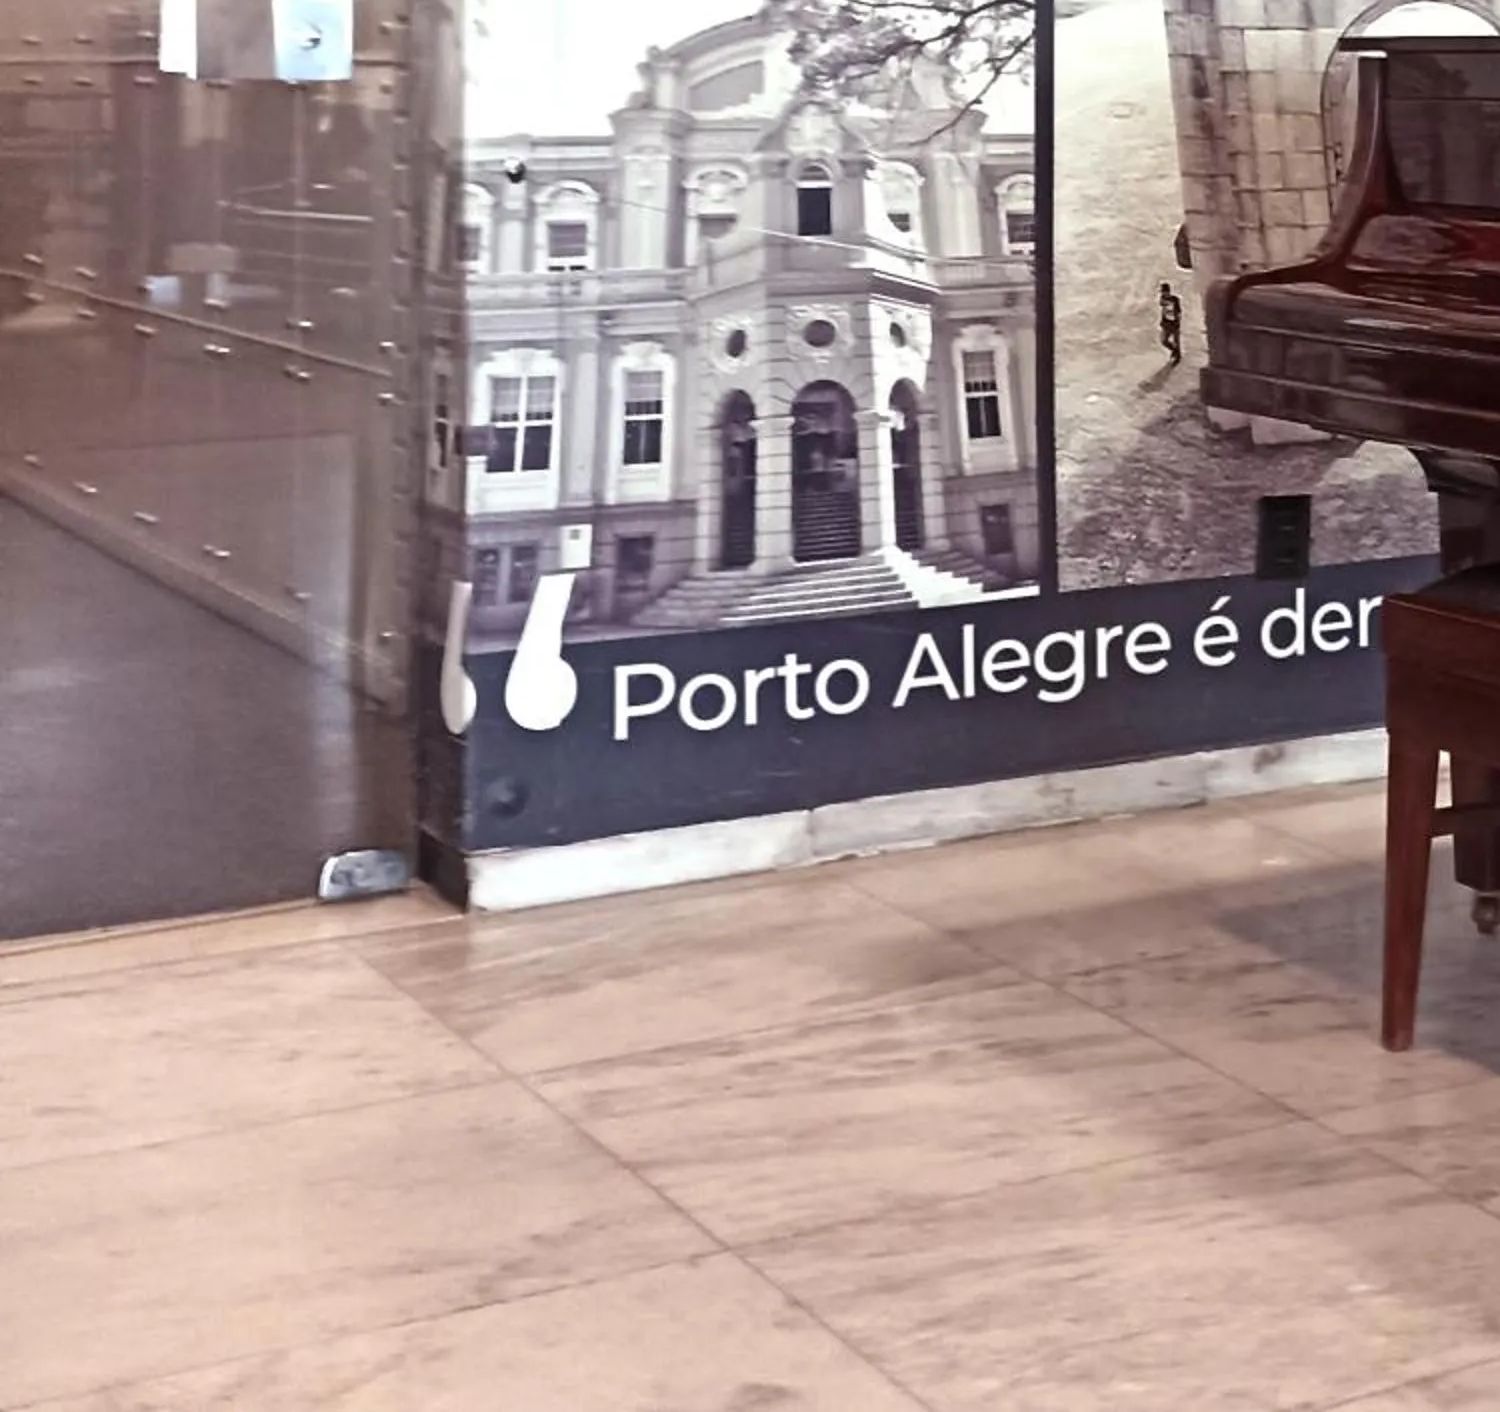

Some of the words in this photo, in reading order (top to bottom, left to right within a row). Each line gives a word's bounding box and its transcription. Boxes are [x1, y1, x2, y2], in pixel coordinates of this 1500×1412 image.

[611, 652, 869, 739] Porto
[892, 621, 1171, 706] Alegre
[1193, 596, 1237, 665] é
